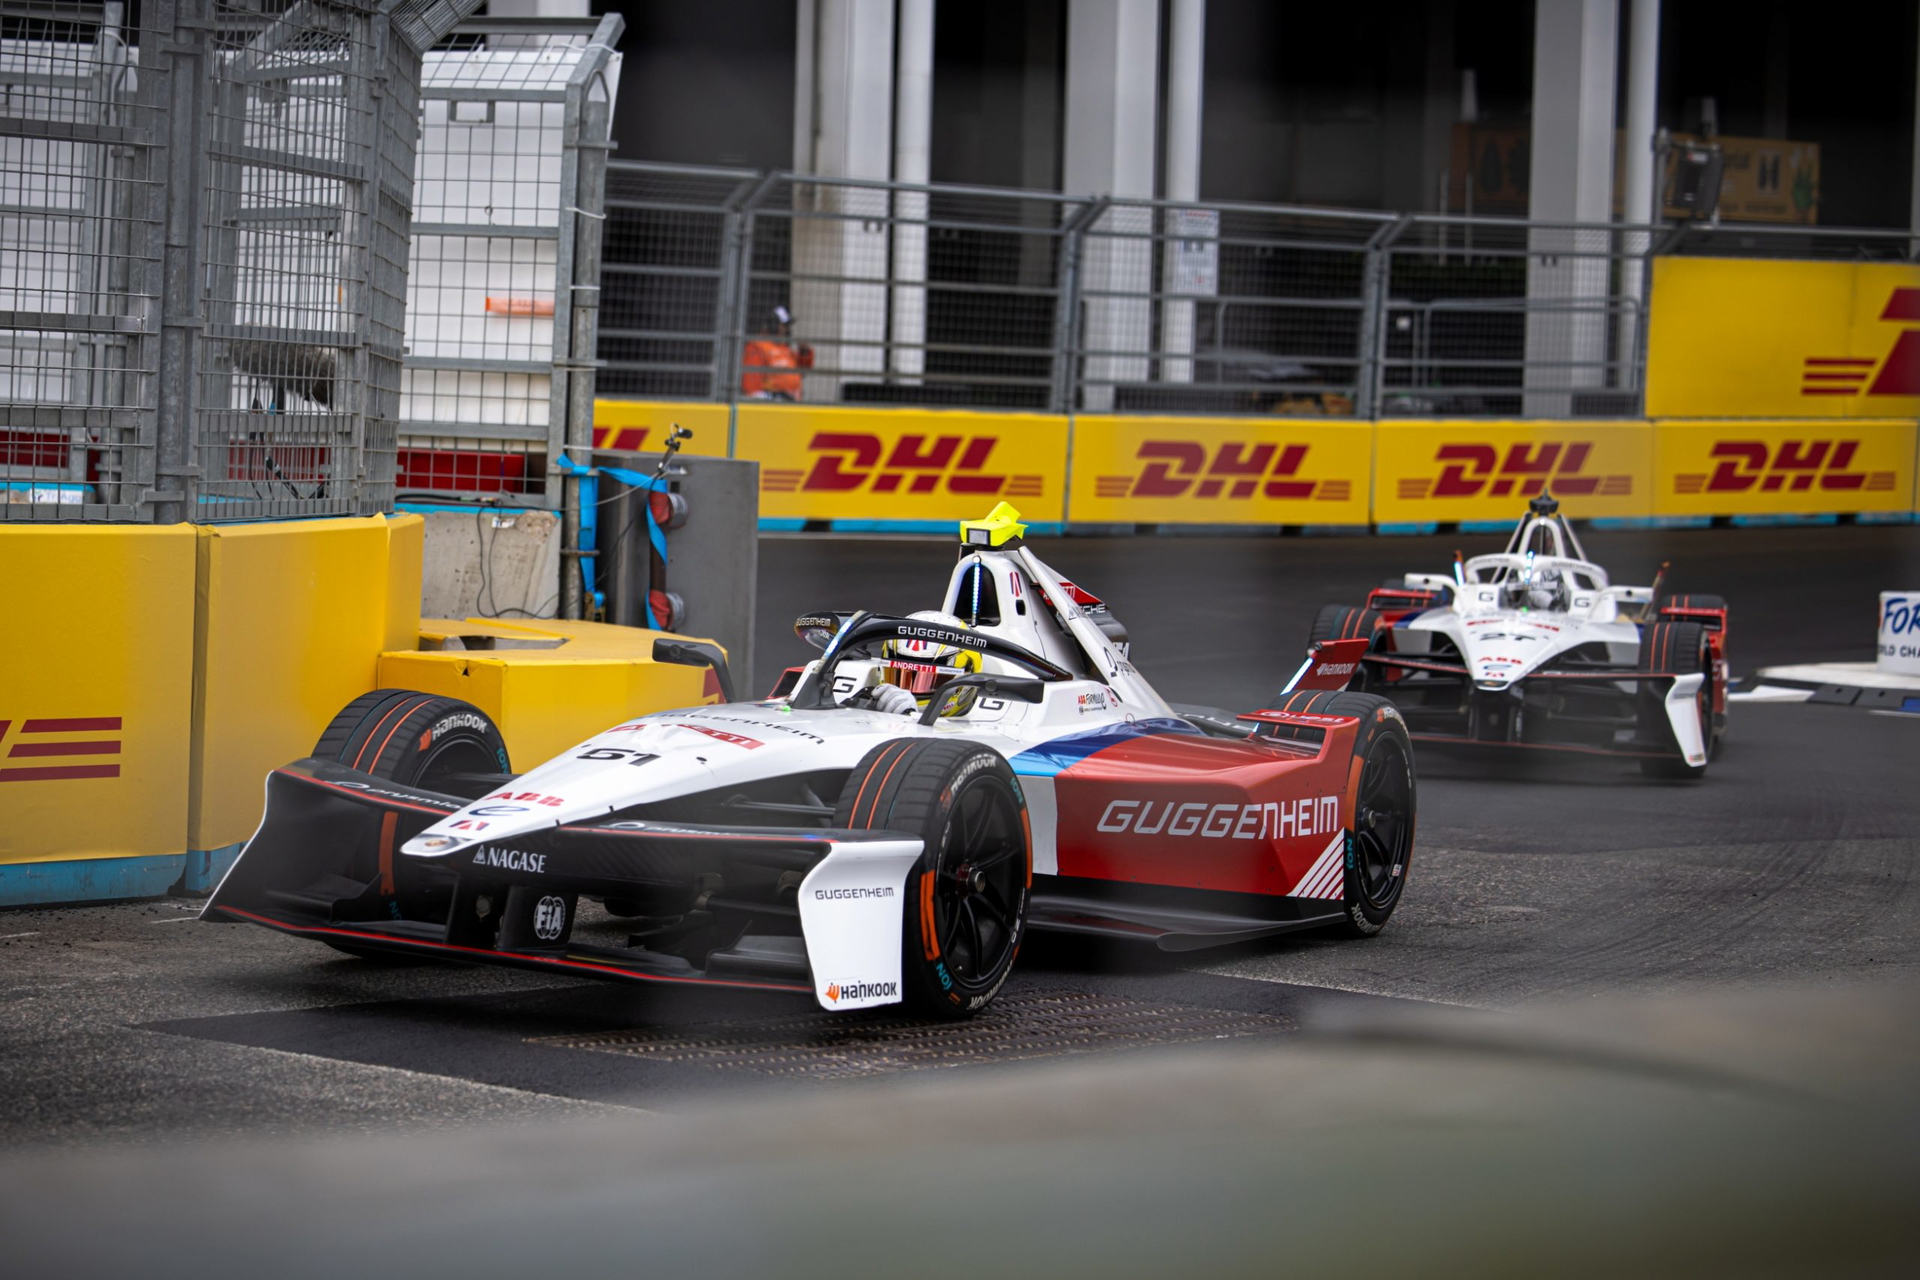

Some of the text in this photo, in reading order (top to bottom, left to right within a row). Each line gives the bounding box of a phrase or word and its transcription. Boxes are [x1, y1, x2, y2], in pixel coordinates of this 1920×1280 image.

[801, 432, 1007, 496] DHL
[1130, 440, 1319, 499] DHL
[1431, 442, 1602, 498] DHL
[1706, 440, 1869, 493] DHL
[897, 625, 988, 649] GUGGENHEIM
[892, 660, 934, 673] ANDRETTI
[576, 748, 662, 767] 51
[486, 791, 566, 808] ABB
[1096, 795, 1339, 841] GUGGENHEIM
[487, 849, 547, 873] NAGASE
[815, 887, 895, 901] GUGGENHEIM
